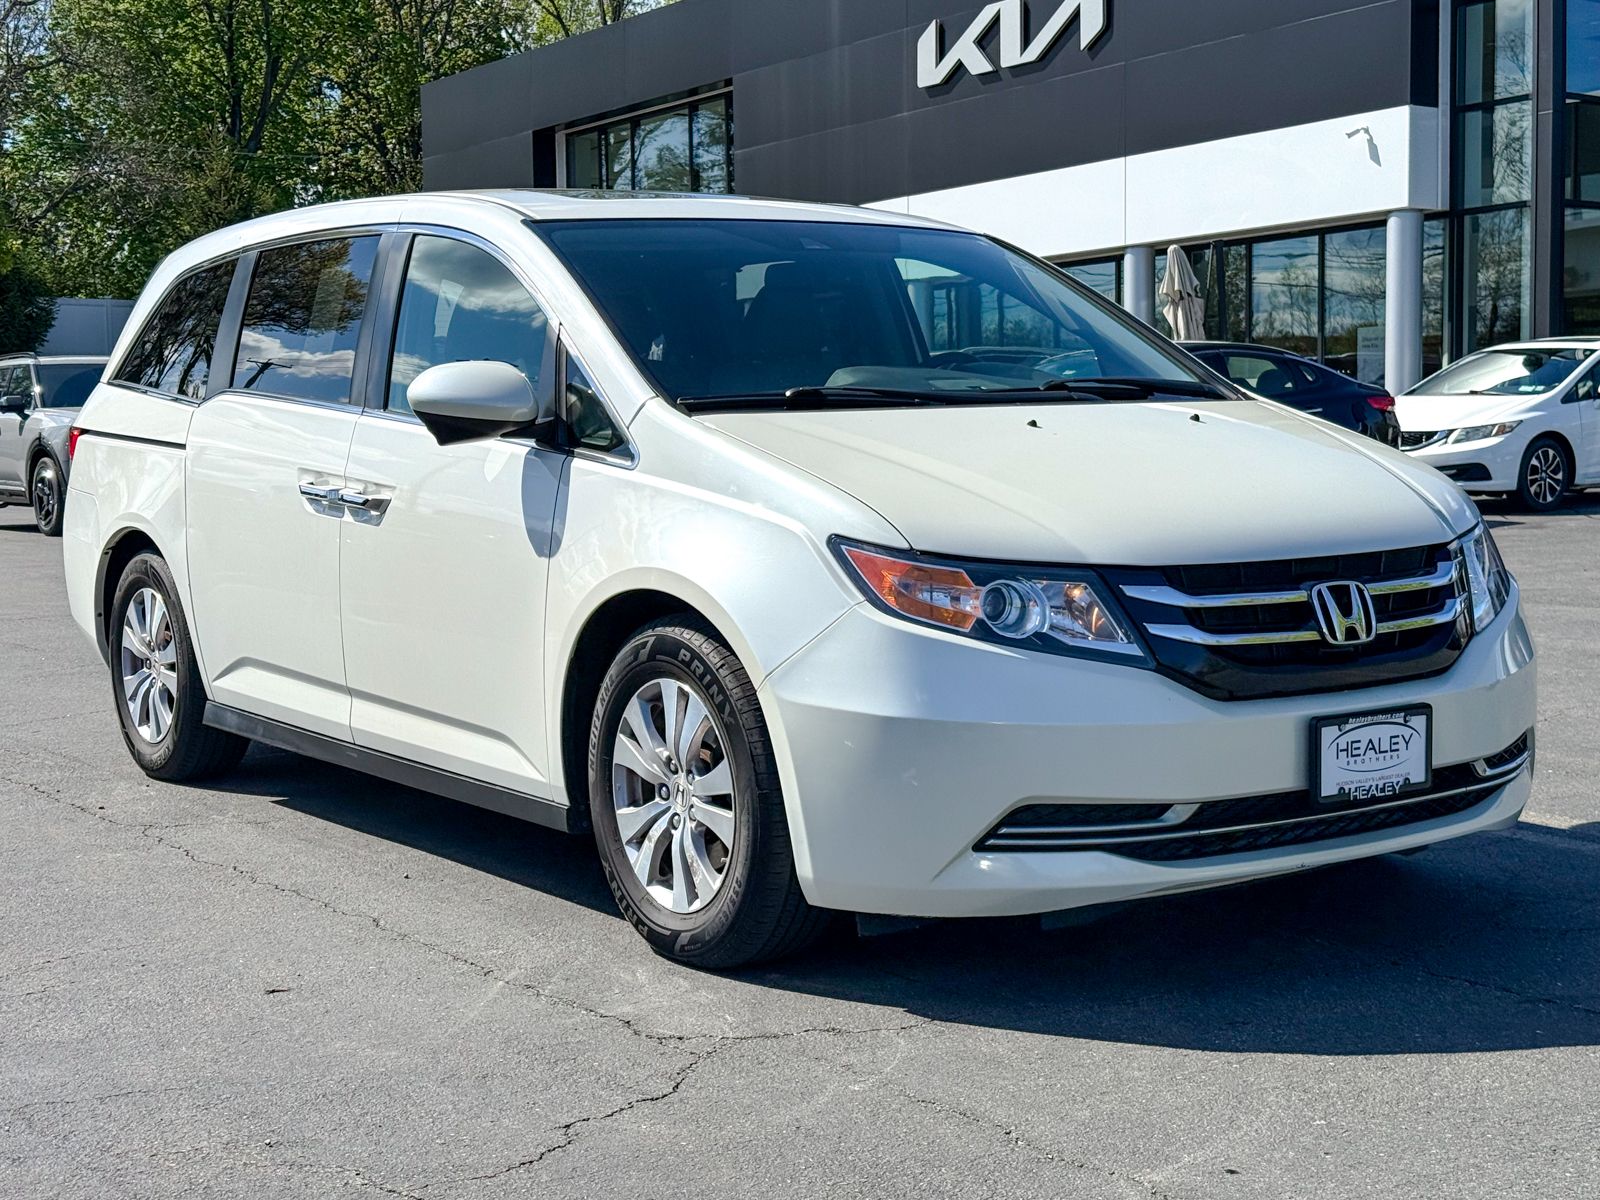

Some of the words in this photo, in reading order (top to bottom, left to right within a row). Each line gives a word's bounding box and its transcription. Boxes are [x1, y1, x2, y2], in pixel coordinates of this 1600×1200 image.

[917, 0, 1107, 88] KIA
[678, 648, 735, 724] PRINX
[1348, 712, 1405, 724] healeybrothers.com
[1336, 732, 1413, 760] HEALEY
[1346, 753, 1400, 766] BROTHERS
[1336, 779, 1354, 787] HUDSON
[1376, 774, 1394, 782] LARGEST
[1350, 782, 1401, 801] HEALEY
[602, 861, 649, 937] PRINX
